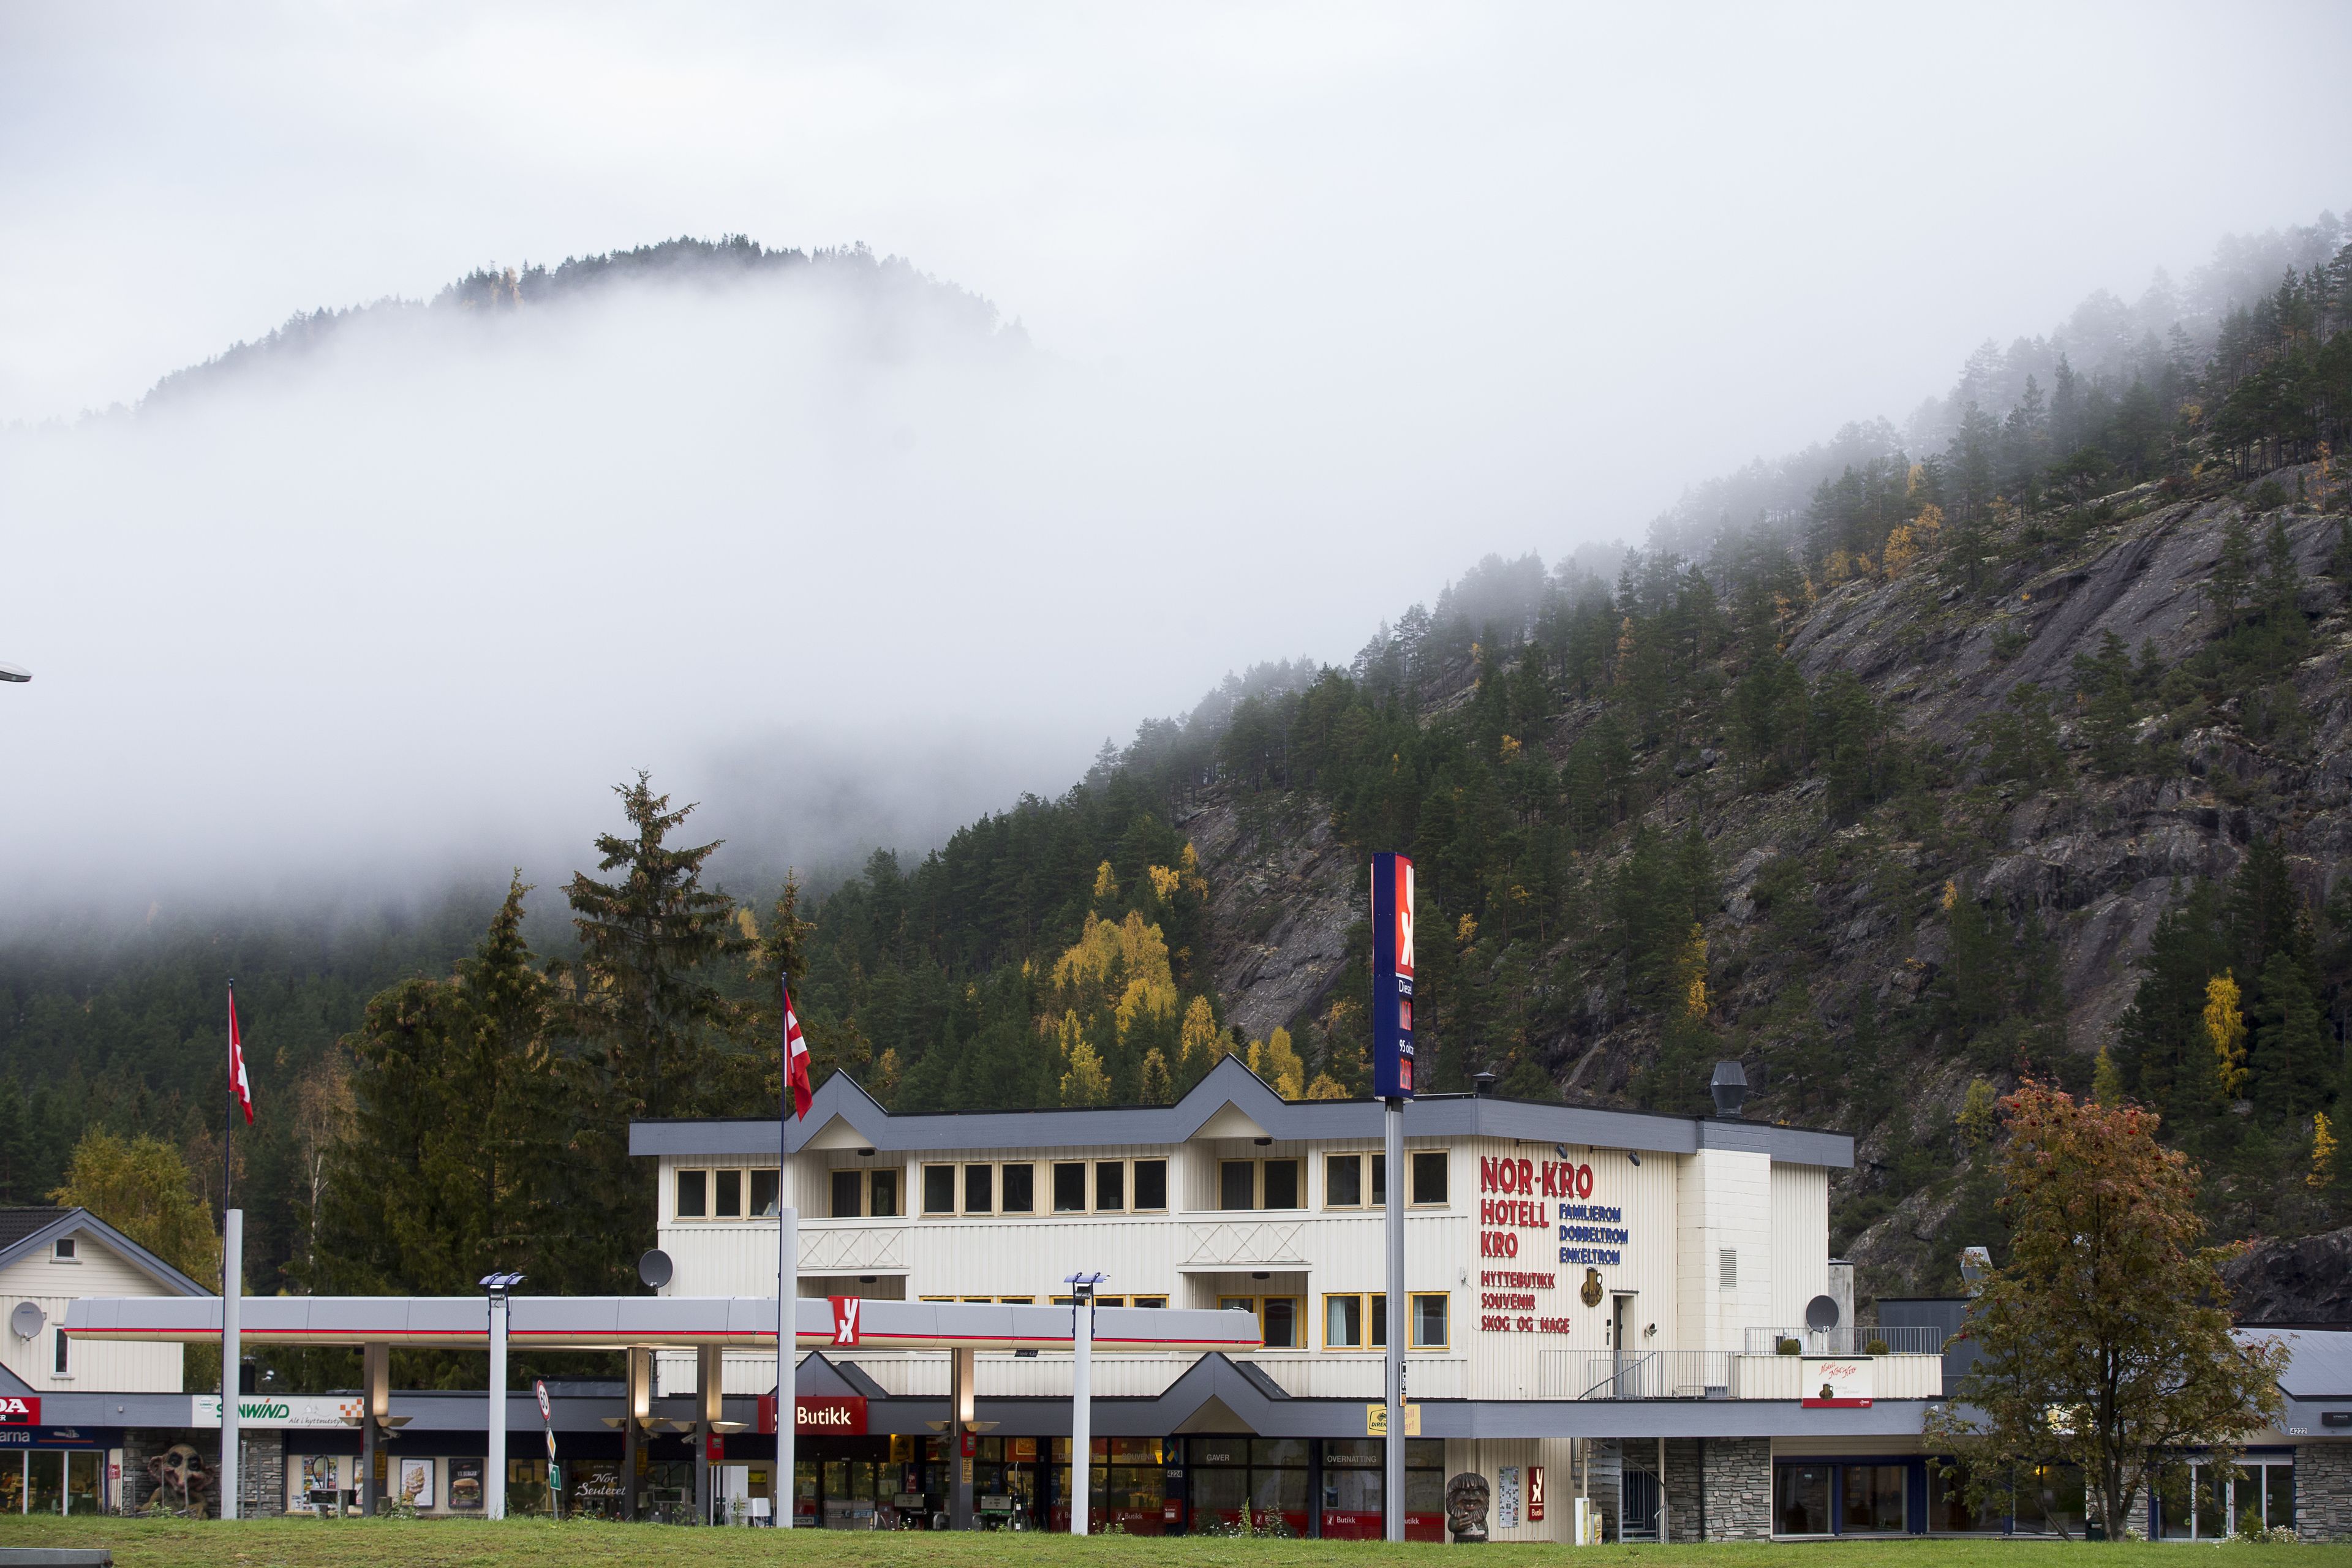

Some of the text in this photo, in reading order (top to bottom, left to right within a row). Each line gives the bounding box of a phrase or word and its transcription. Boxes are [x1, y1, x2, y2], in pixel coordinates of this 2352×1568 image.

[1399, 979, 1412, 995] Diesel
[1399, 1039, 1406, 1053] 95
[1481, 1156, 1593, 1199] NOR-KRO
[1481, 1199, 1549, 1227] HOTELL
[1559, 1203, 1621, 1223] FAMILIEROM
[1559, 1225, 1628, 1244] DOBBELTROM
[1481, 1231, 1518, 1258] KRO
[1559, 1247, 1620, 1265] ENKELTROM
[1481, 1270, 1555, 1289] HYTTEBUTIKK
[1481, 1293, 1536, 1310] SOUVENIR
[1481, 1315, 1570, 1333] SKOG OG HAGE
[216, 1398, 290, 1419] SNWIND
[797, 1407, 851, 1425] Butikk
[590, 1472, 618, 1483] Nor
